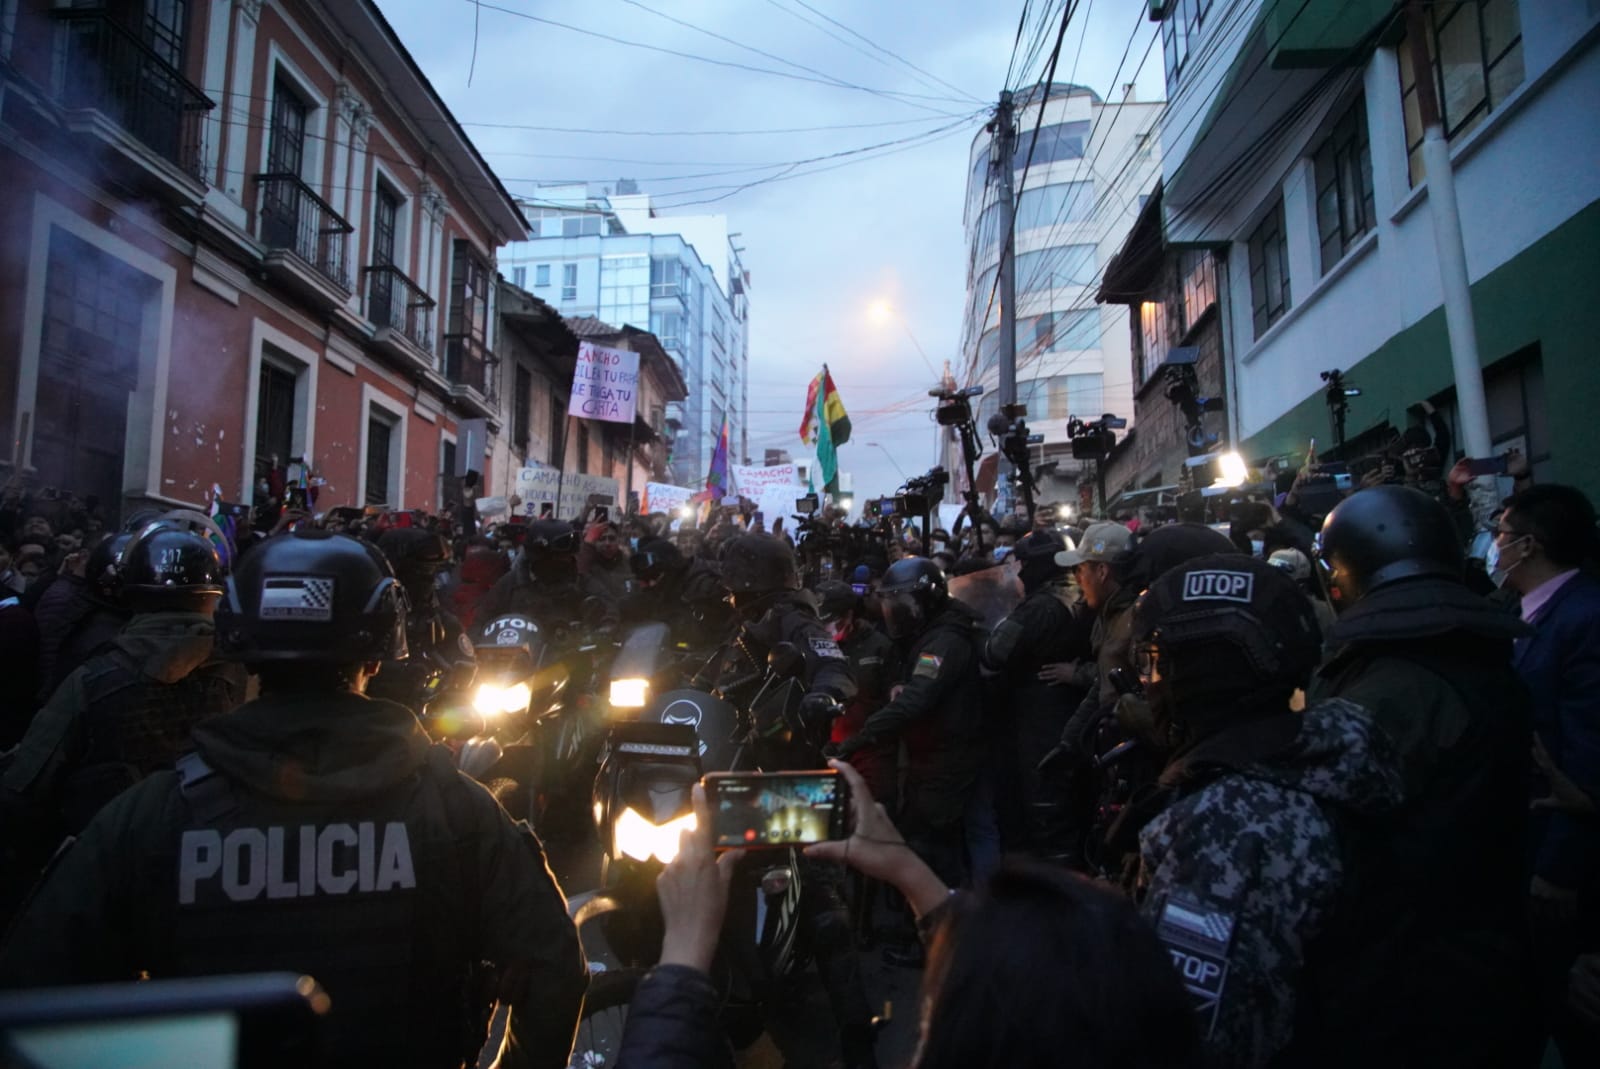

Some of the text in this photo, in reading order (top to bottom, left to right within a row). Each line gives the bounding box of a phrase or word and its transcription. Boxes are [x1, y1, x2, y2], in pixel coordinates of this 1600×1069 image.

[616, 389, 631, 401] TU
[1190, 574, 1246, 595] UTOP
[484, 618, 538, 636] UTOP
[179, 822, 417, 904] POLICIA
[1169, 949, 1220, 983] TOP
